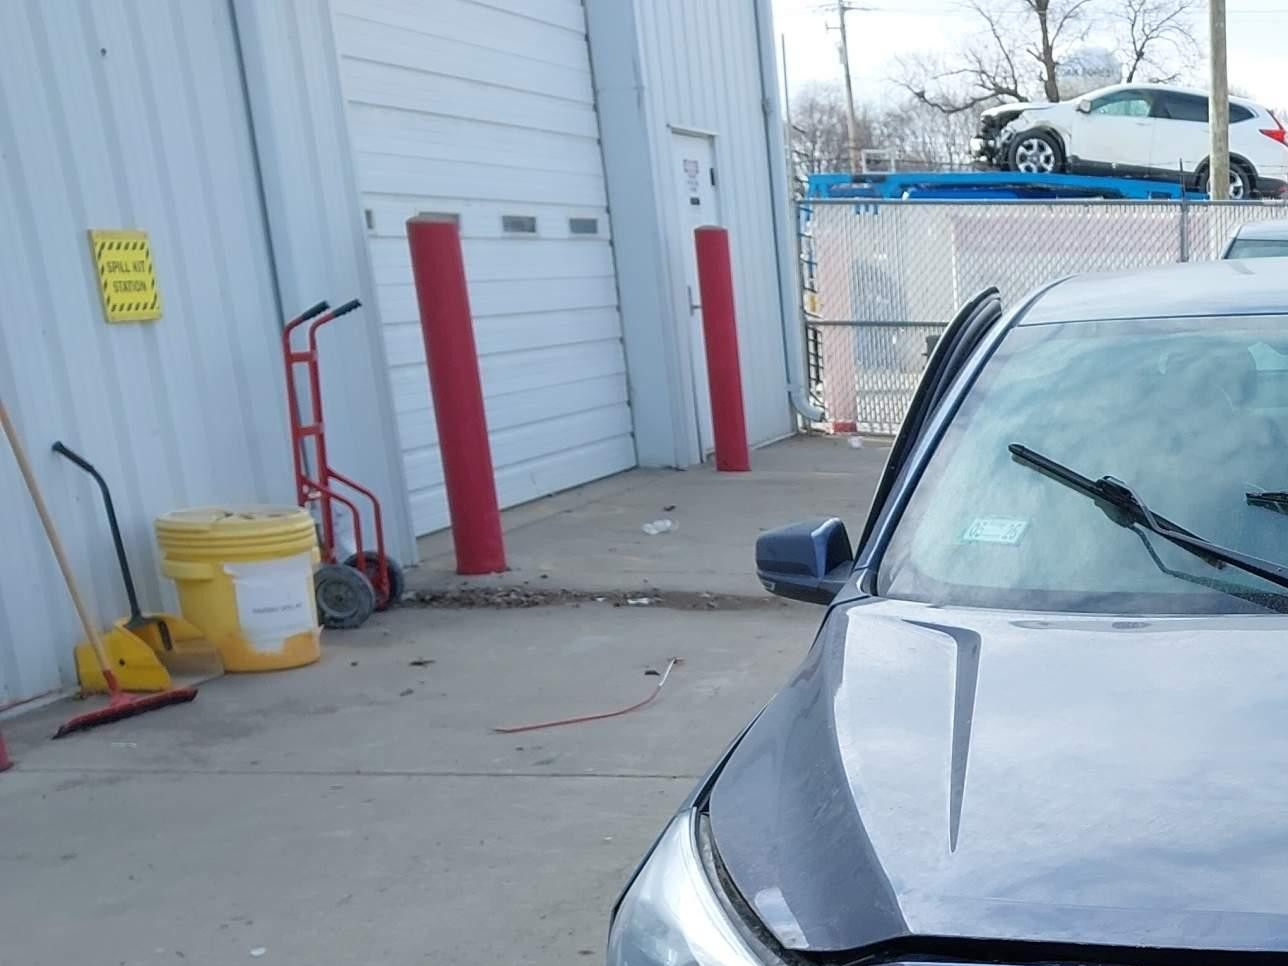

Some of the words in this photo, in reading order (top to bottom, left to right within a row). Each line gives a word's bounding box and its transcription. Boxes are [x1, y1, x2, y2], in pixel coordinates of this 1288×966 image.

[106, 260, 131, 273] SPILL
[132, 260, 145, 273] KIT
[112, 279, 147, 293] STATION
